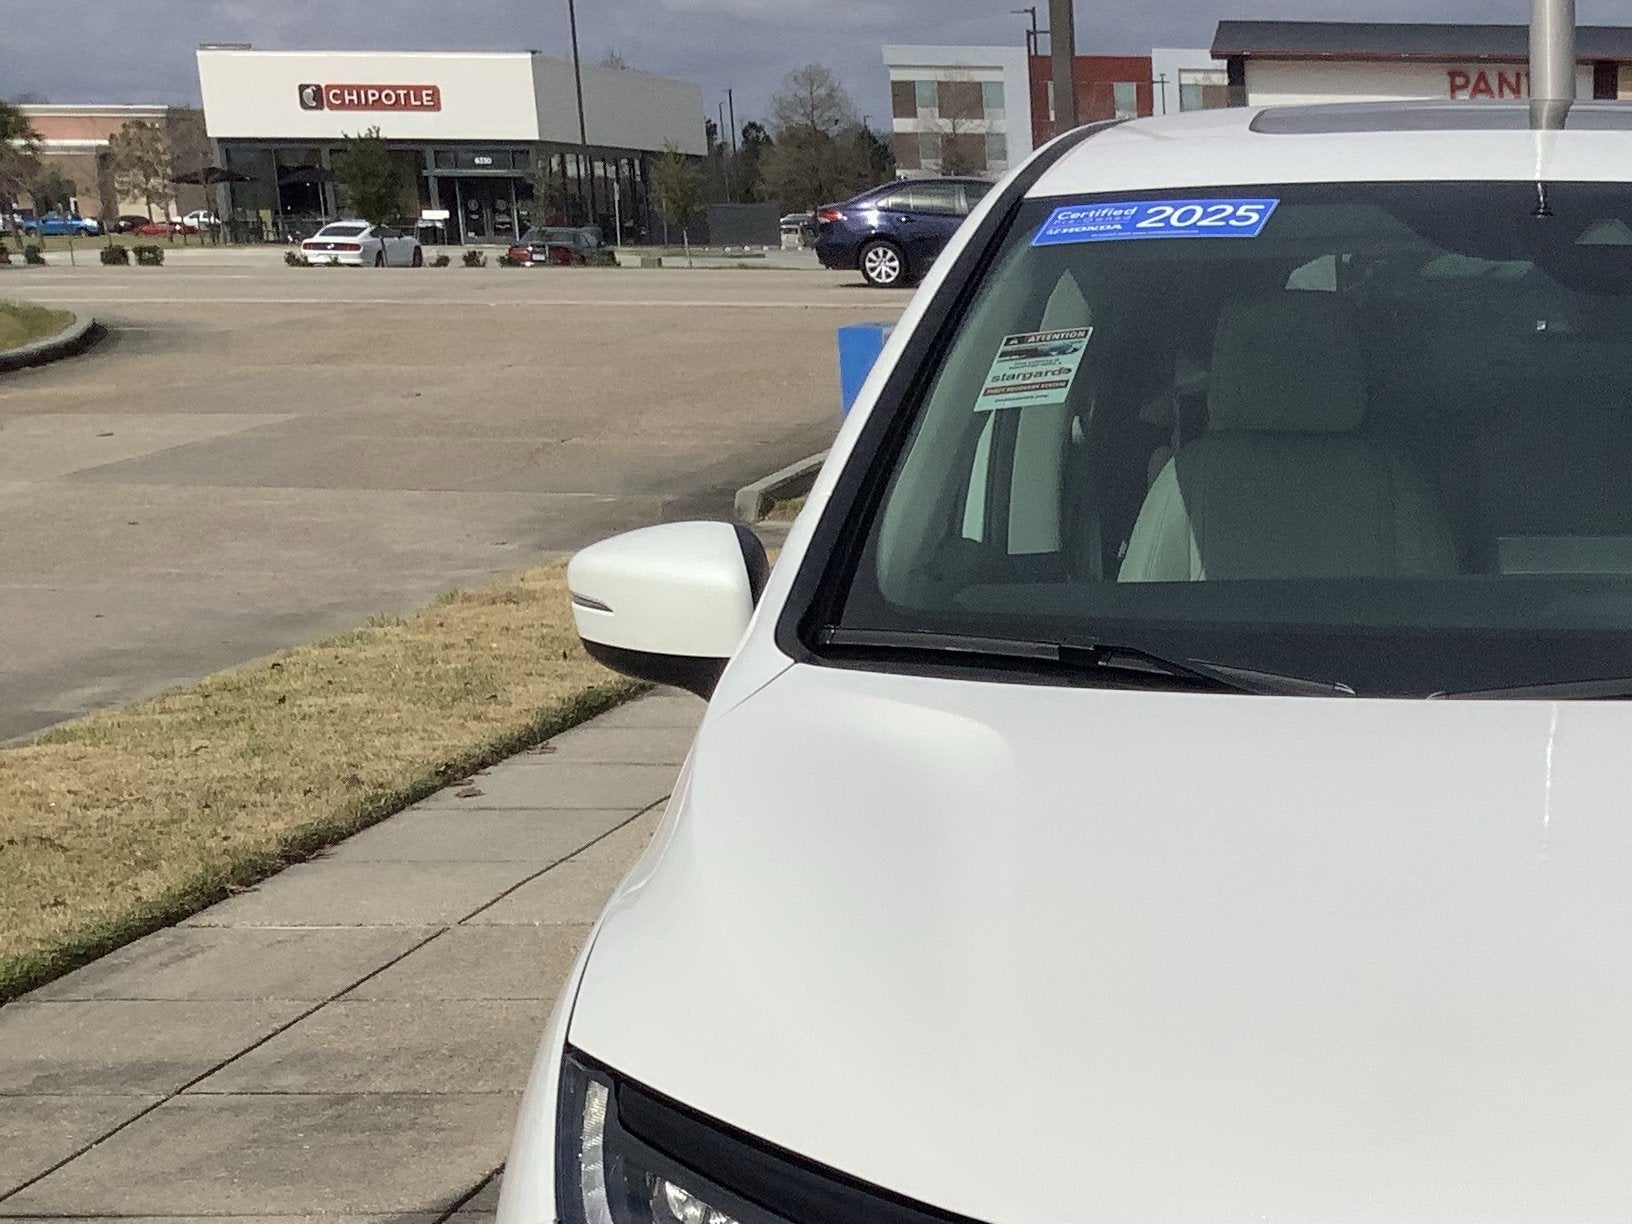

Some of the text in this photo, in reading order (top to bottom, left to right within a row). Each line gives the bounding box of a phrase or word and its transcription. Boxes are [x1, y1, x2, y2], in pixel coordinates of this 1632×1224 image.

[1447, 69, 1530, 100] PAN
[329, 89, 434, 106] CHIPOTLE
[1058, 206, 1138, 220] Certified
[1136, 205, 1265, 228] 2025
[1061, 224, 1122, 233] HONDA
[1027, 330, 1086, 343] ATTENTION
